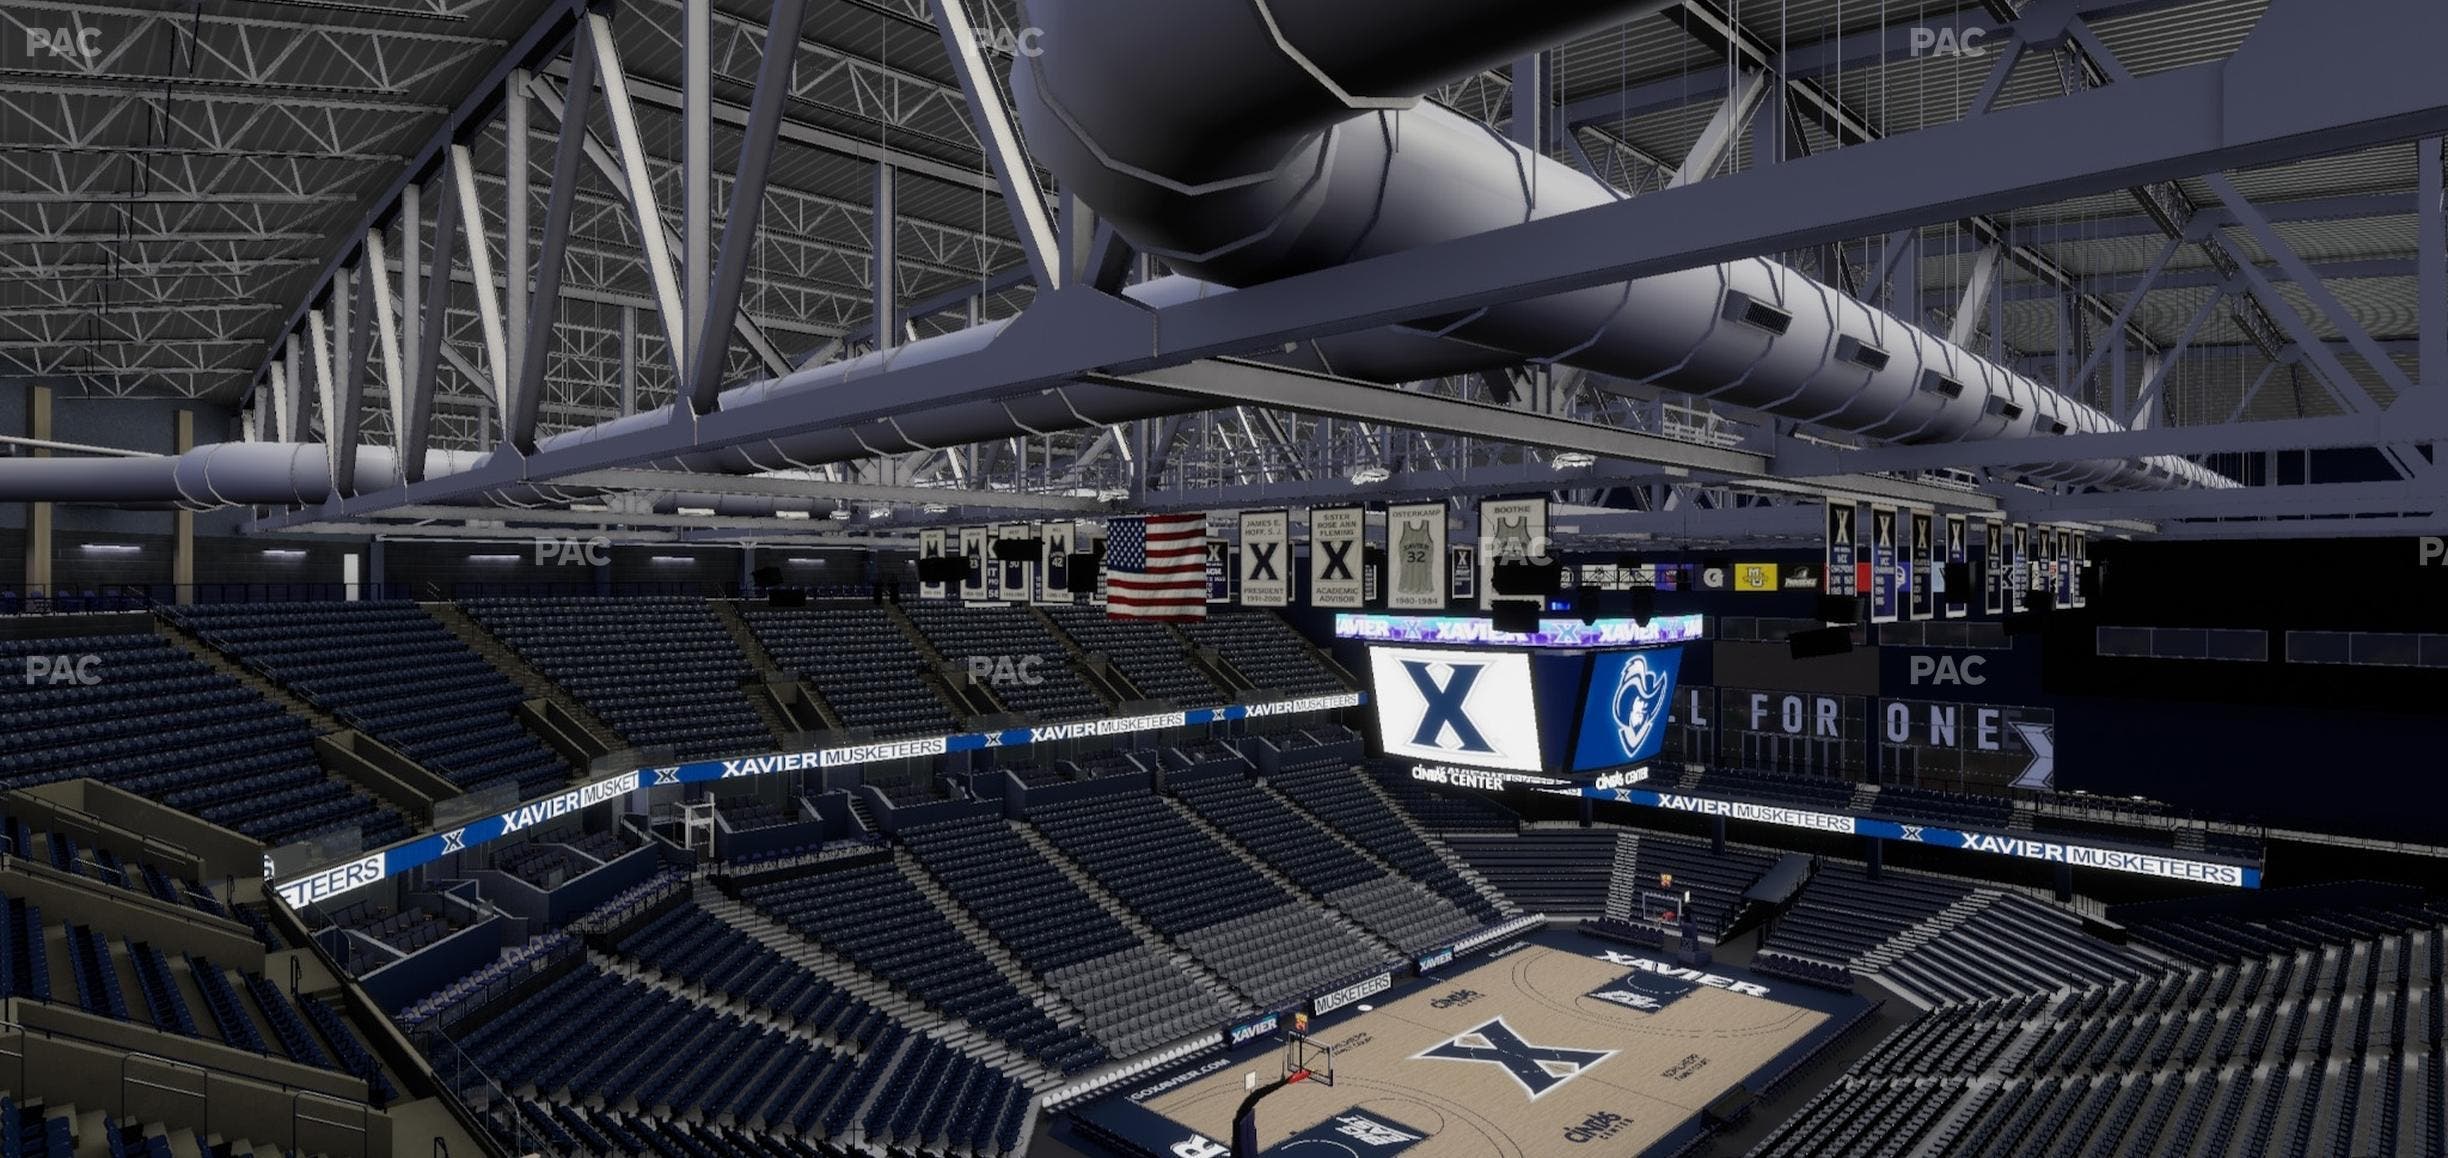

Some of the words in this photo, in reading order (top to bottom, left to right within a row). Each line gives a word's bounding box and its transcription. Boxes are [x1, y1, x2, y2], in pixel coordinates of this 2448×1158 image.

[1392, 509, 1440, 518] OSTERKAMP
[1494, 506, 1530, 514] BOOTHE
[1835, 509, 1850, 544] X
[1320, 528, 1354, 536] FLEMING
[1878, 515, 1891, 548] X
[1249, 542, 1279, 580] X
[1320, 540, 1353, 580] X
[1406, 551, 1426, 563] 32
[1396, 657, 1503, 756] X
[1751, 694, 1838, 737] FOR
[1887, 702, 2000, 750] ONE
[501, 794, 580, 836] XAVIER
[584, 774, 638, 805] MUSKET
[720, 752, 818, 779] XAVIER
[825, 739, 943, 765] MUSKETEERS
[1030, 722, 1096, 743] XAVIER
[1100, 714, 1183, 733] MUSKETEERS
[1244, 702, 1292, 718] XAVIER
[1295, 695, 1358, 711] MUSKETEERS
[1450, 774, 1504, 791] CENTER
[1626, 766, 1649, 785] CENTER
[1658, 794, 1732, 816] XAVIER
[1736, 804, 1852, 831] MUSKETEERS
[1961, 832, 2064, 862] XAVIER
[2072, 848, 2236, 882] MUSKETEERS
[1420, 952, 1452, 972] XAVIER
[1594, 950, 1770, 997] XAVIER
[1316, 973, 1391, 1014] MUSKETEERS
[1232, 1018, 1278, 1044] XAVIER
[1130, 1058, 1232, 1100] GOXAVIER.COM
[1600, 1118, 1634, 1141] CENTER
